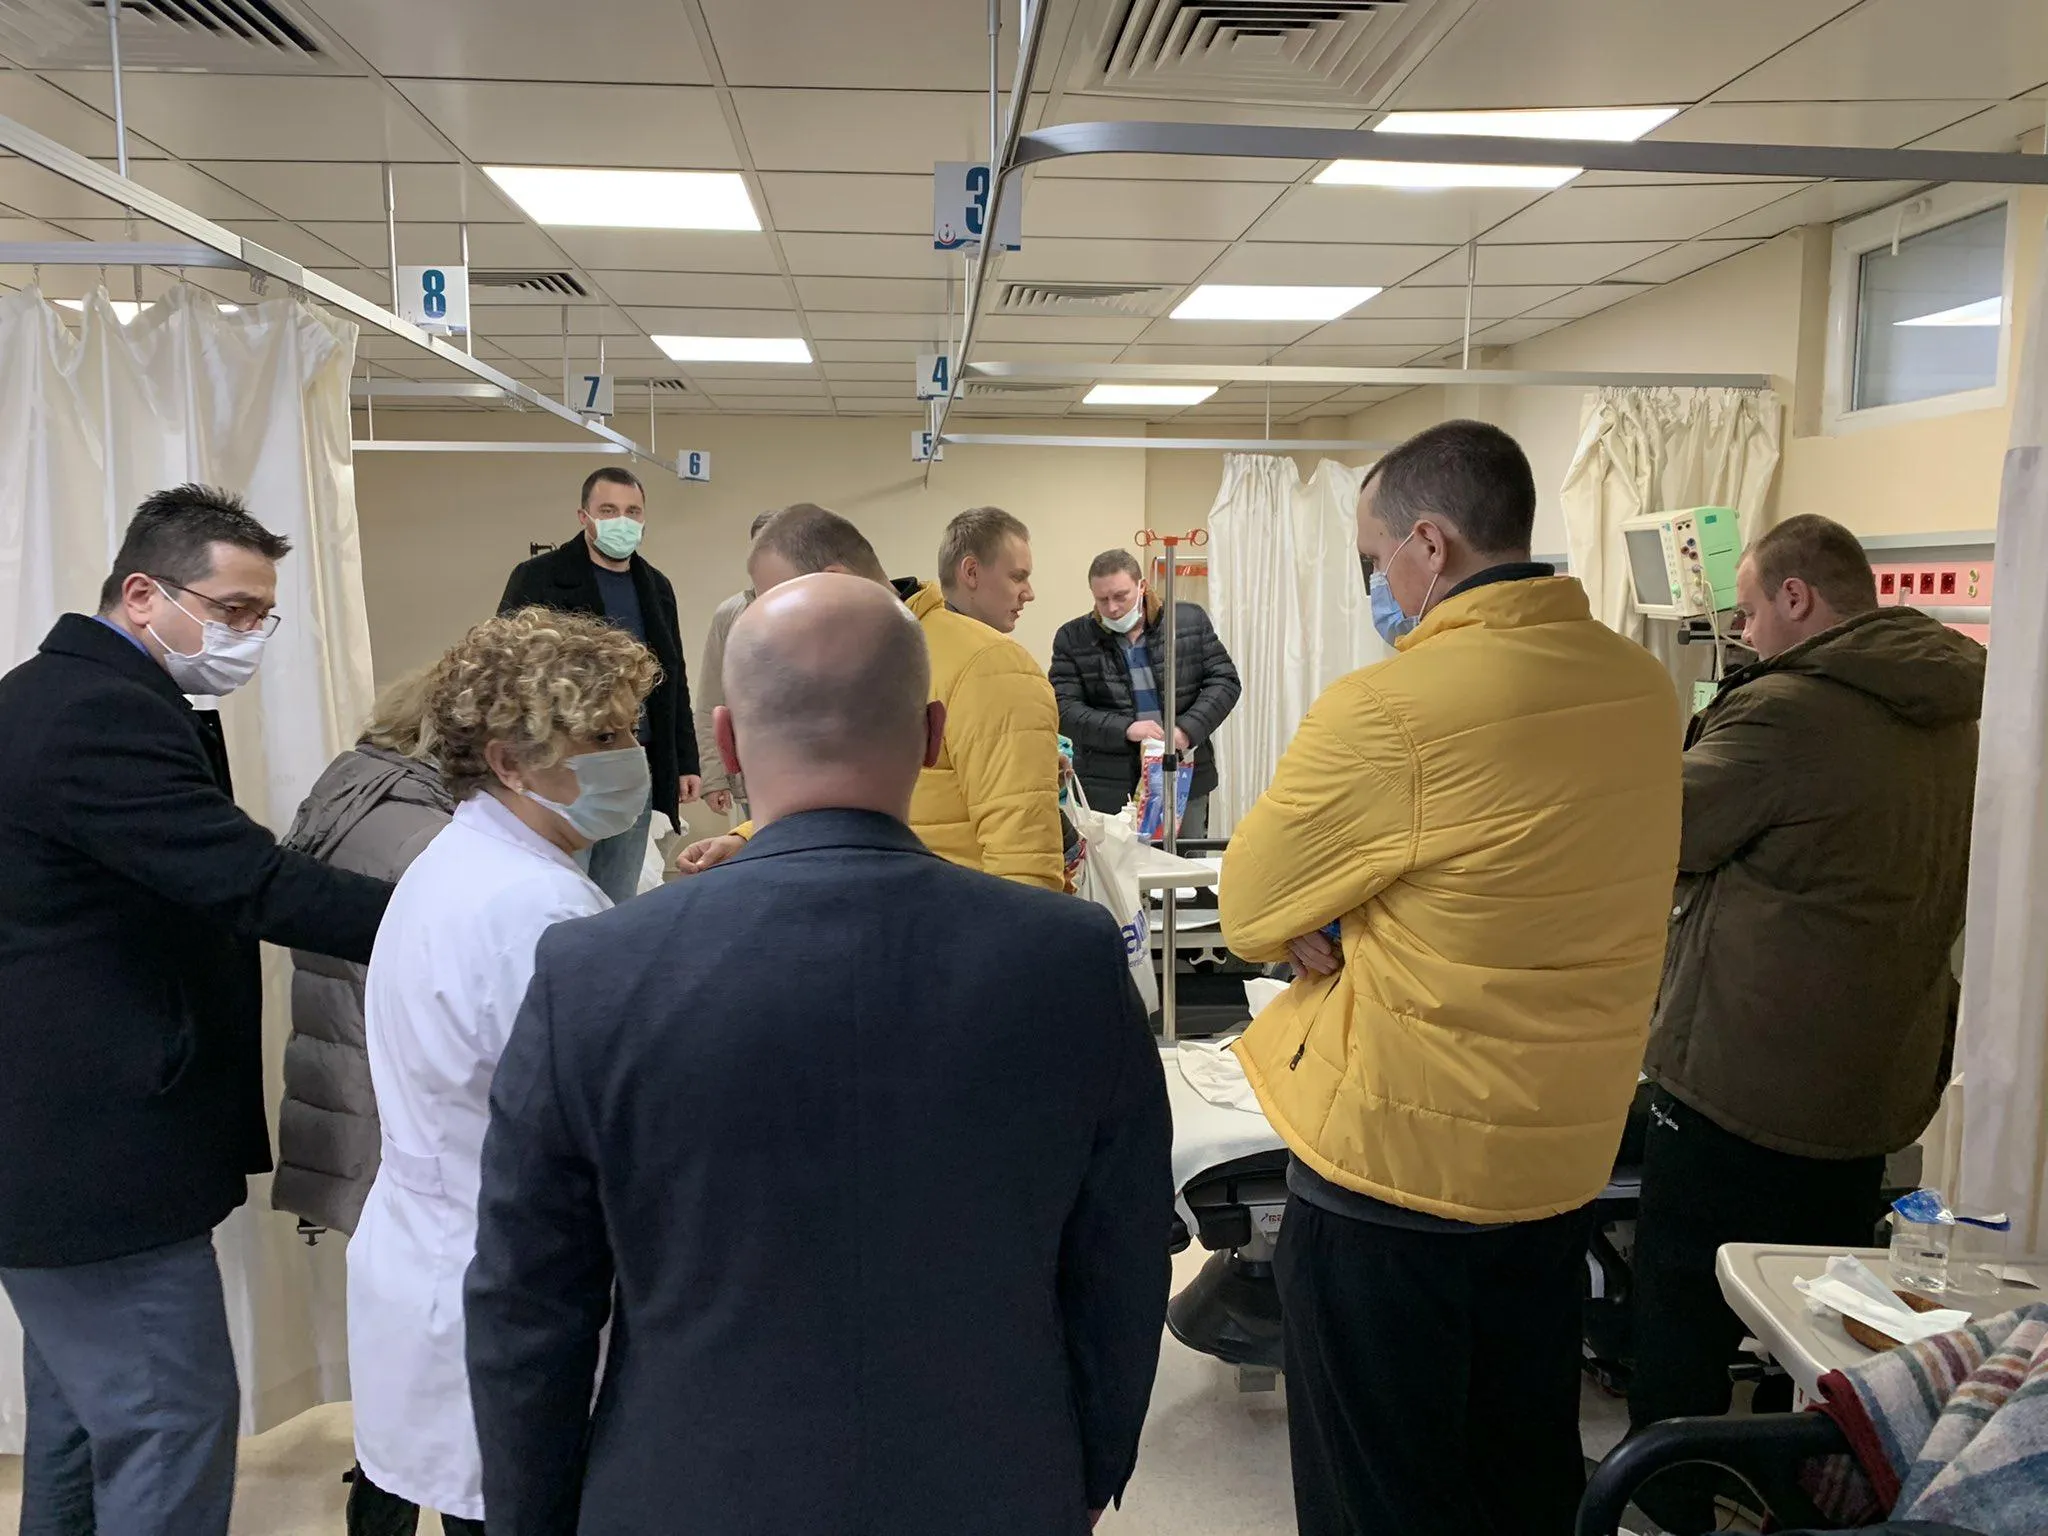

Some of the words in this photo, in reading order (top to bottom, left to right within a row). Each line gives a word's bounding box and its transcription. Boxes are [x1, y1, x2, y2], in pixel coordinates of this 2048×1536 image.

[966, 167, 991, 234] 3
[422, 269, 446, 319] 8
[932, 356, 949, 391] 4
[583, 376, 600, 408] 7
[922, 433, 932, 456] 5
[689, 452, 701, 476] 6
